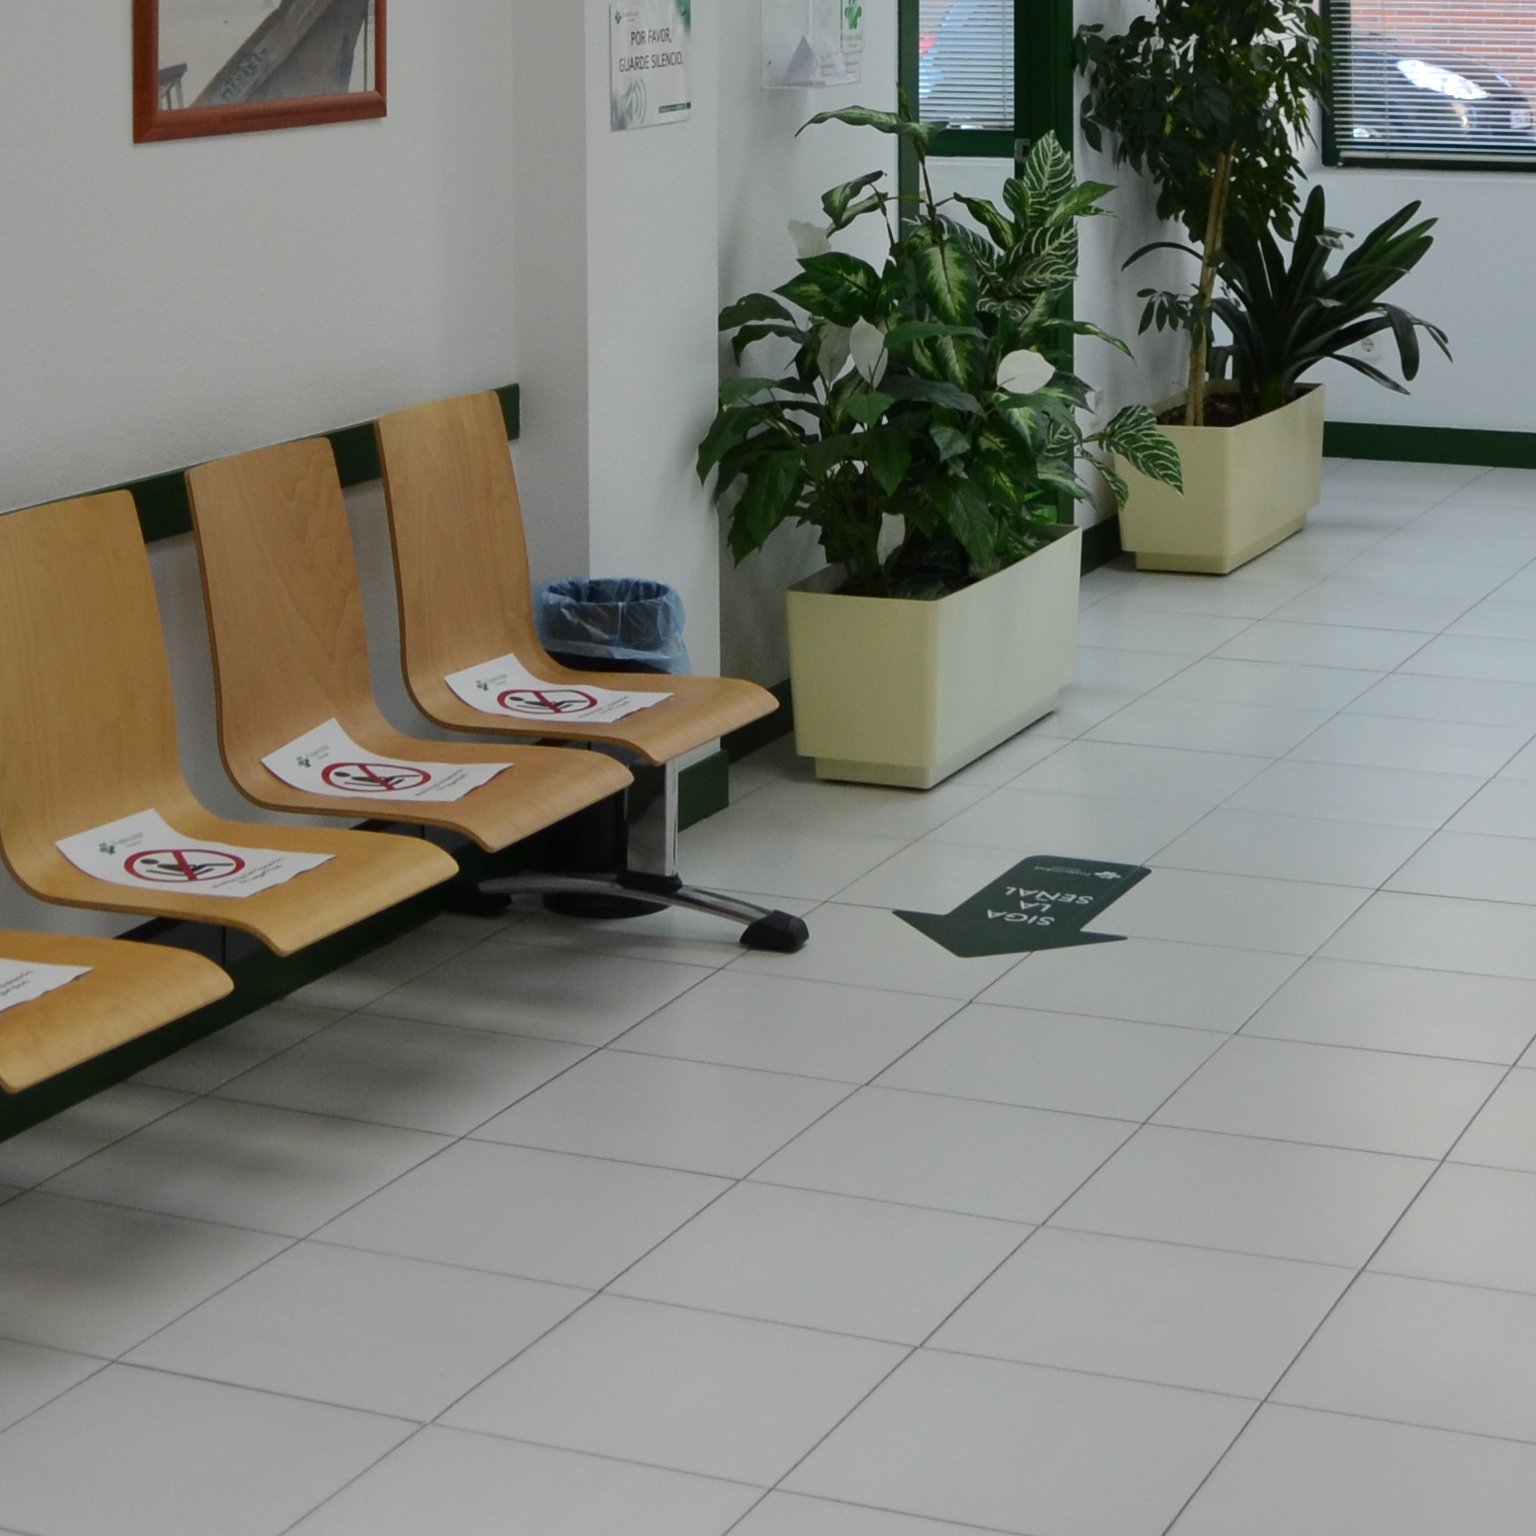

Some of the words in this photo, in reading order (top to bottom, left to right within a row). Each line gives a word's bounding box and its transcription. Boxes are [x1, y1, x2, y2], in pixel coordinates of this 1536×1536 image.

[631, 31, 646, 46] POR
[619, 55, 649, 72] GUARDE
[1019, 900, 1052, 913] LA
[987, 909, 1055, 926] SIGA
